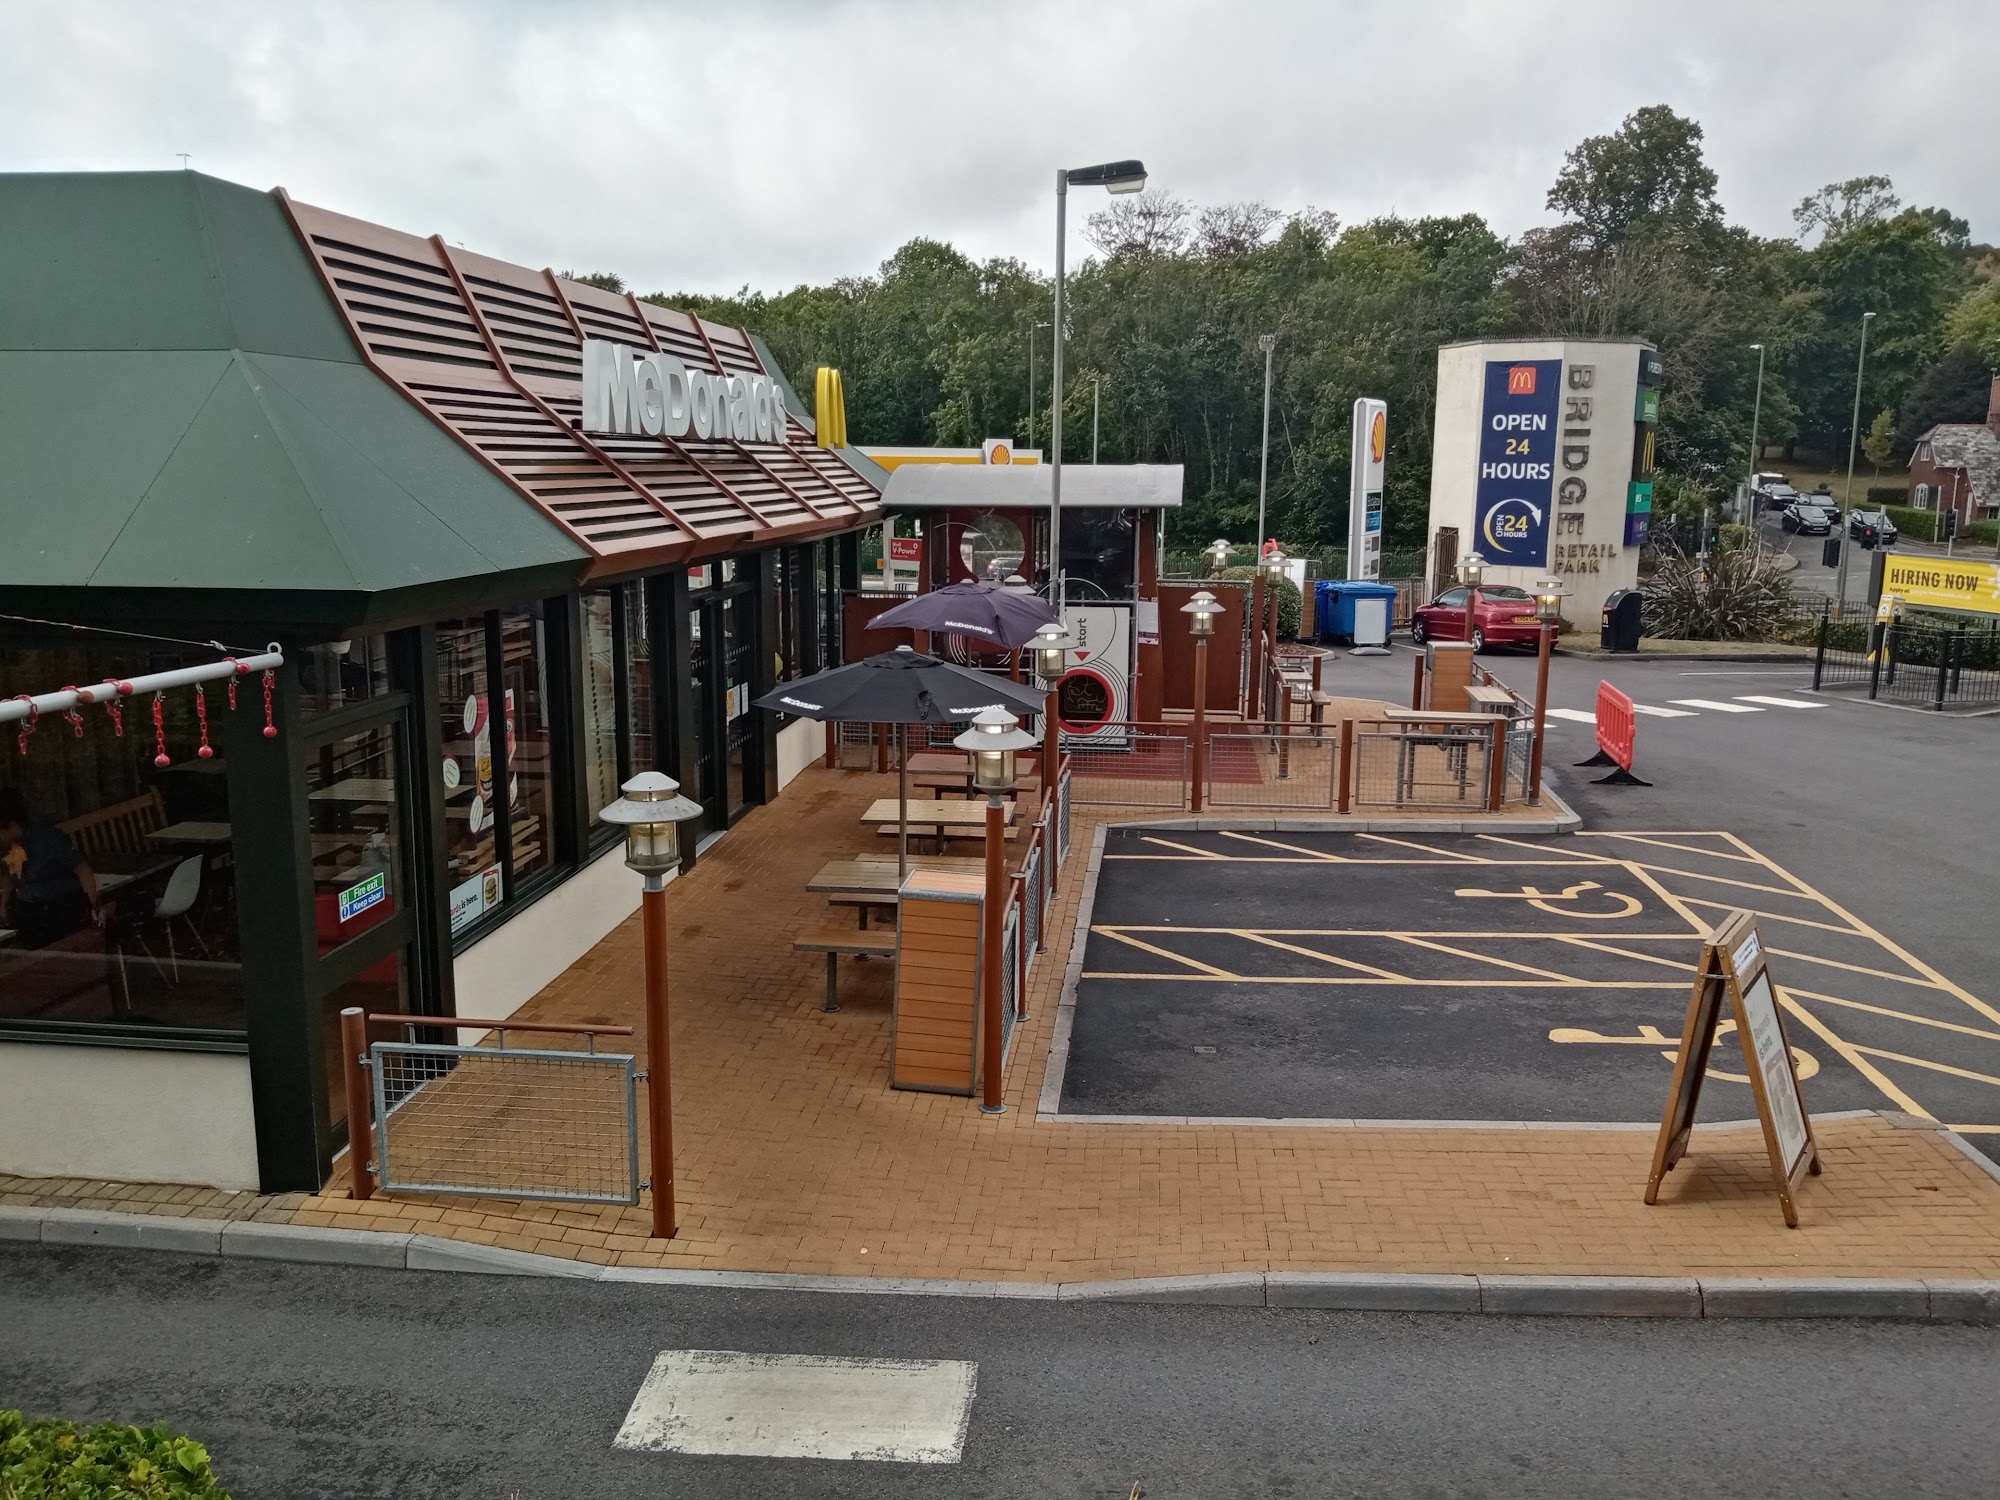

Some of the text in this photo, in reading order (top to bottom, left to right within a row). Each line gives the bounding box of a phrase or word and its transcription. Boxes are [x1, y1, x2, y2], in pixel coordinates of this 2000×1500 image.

[582, 339, 787, 444] McDonald's
[1492, 414, 1547, 431] OPEN
[1505, 438, 1530, 455] 24
[1556, 364, 1596, 535] BRIDGE
[1482, 462, 1551, 480] HOURS
[1495, 514, 1528, 538] OPEN 24
[893, 547, 916, 555] V-Power
[1555, 544, 1617, 558] RETAIL
[1554, 559, 1600, 574] PARK
[1890, 568, 1979, 591] HIRING NOW
[944, 620, 994, 635] McDonald's
[1077, 617, 1087, 647] start
[353, 879, 378, 899] Fire exit
[353, 891, 382, 912] Keep clear
